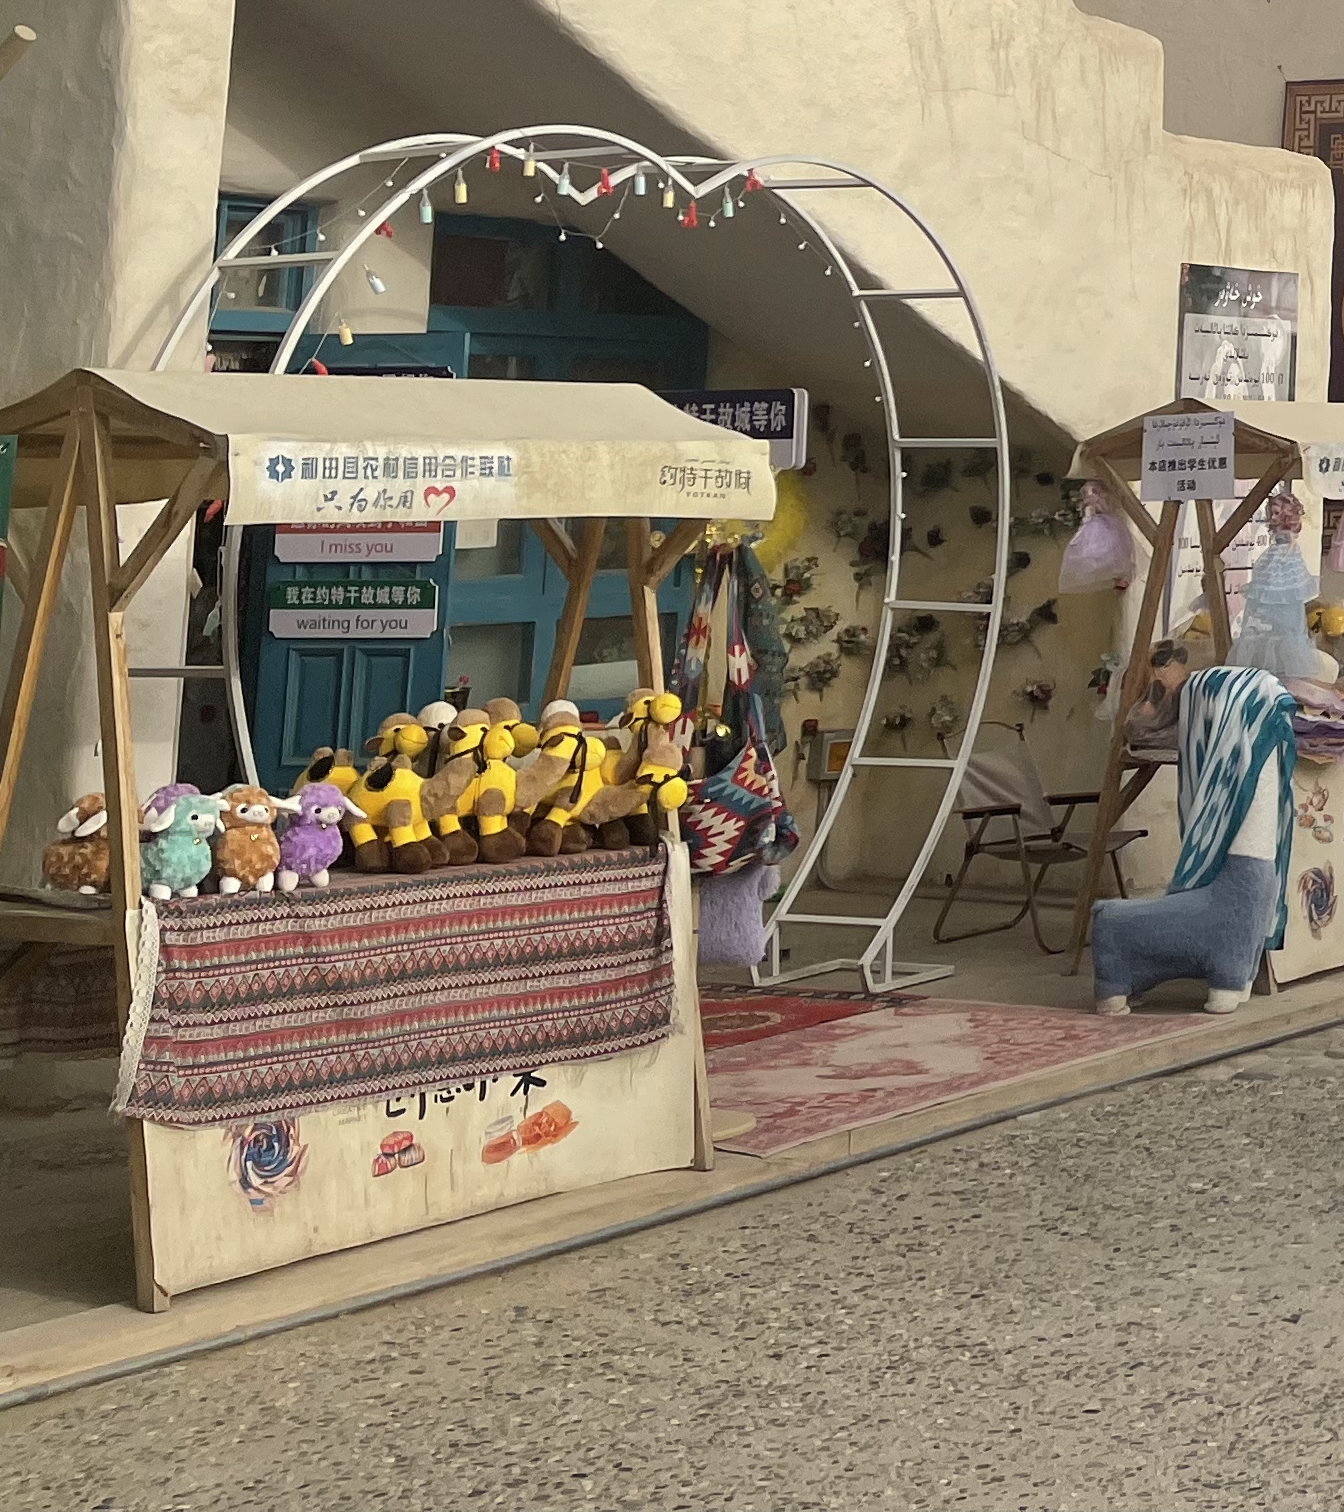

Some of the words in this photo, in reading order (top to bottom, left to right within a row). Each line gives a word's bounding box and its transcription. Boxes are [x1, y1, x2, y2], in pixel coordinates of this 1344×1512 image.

[300, 455, 513, 480] 和田县农村信用合作联社
[1177, 479, 1197, 492] 活动
[316, 487, 415, 513] 只为你用
[320, 540, 325, 554] I
[328, 538, 362, 554] miss
[366, 543, 394, 557] you
[286, 586, 421, 605] 我在约特干故城等你
[296, 616, 350, 634] waiting
[355, 614, 376, 630] for
[379, 618, 408, 634] you
